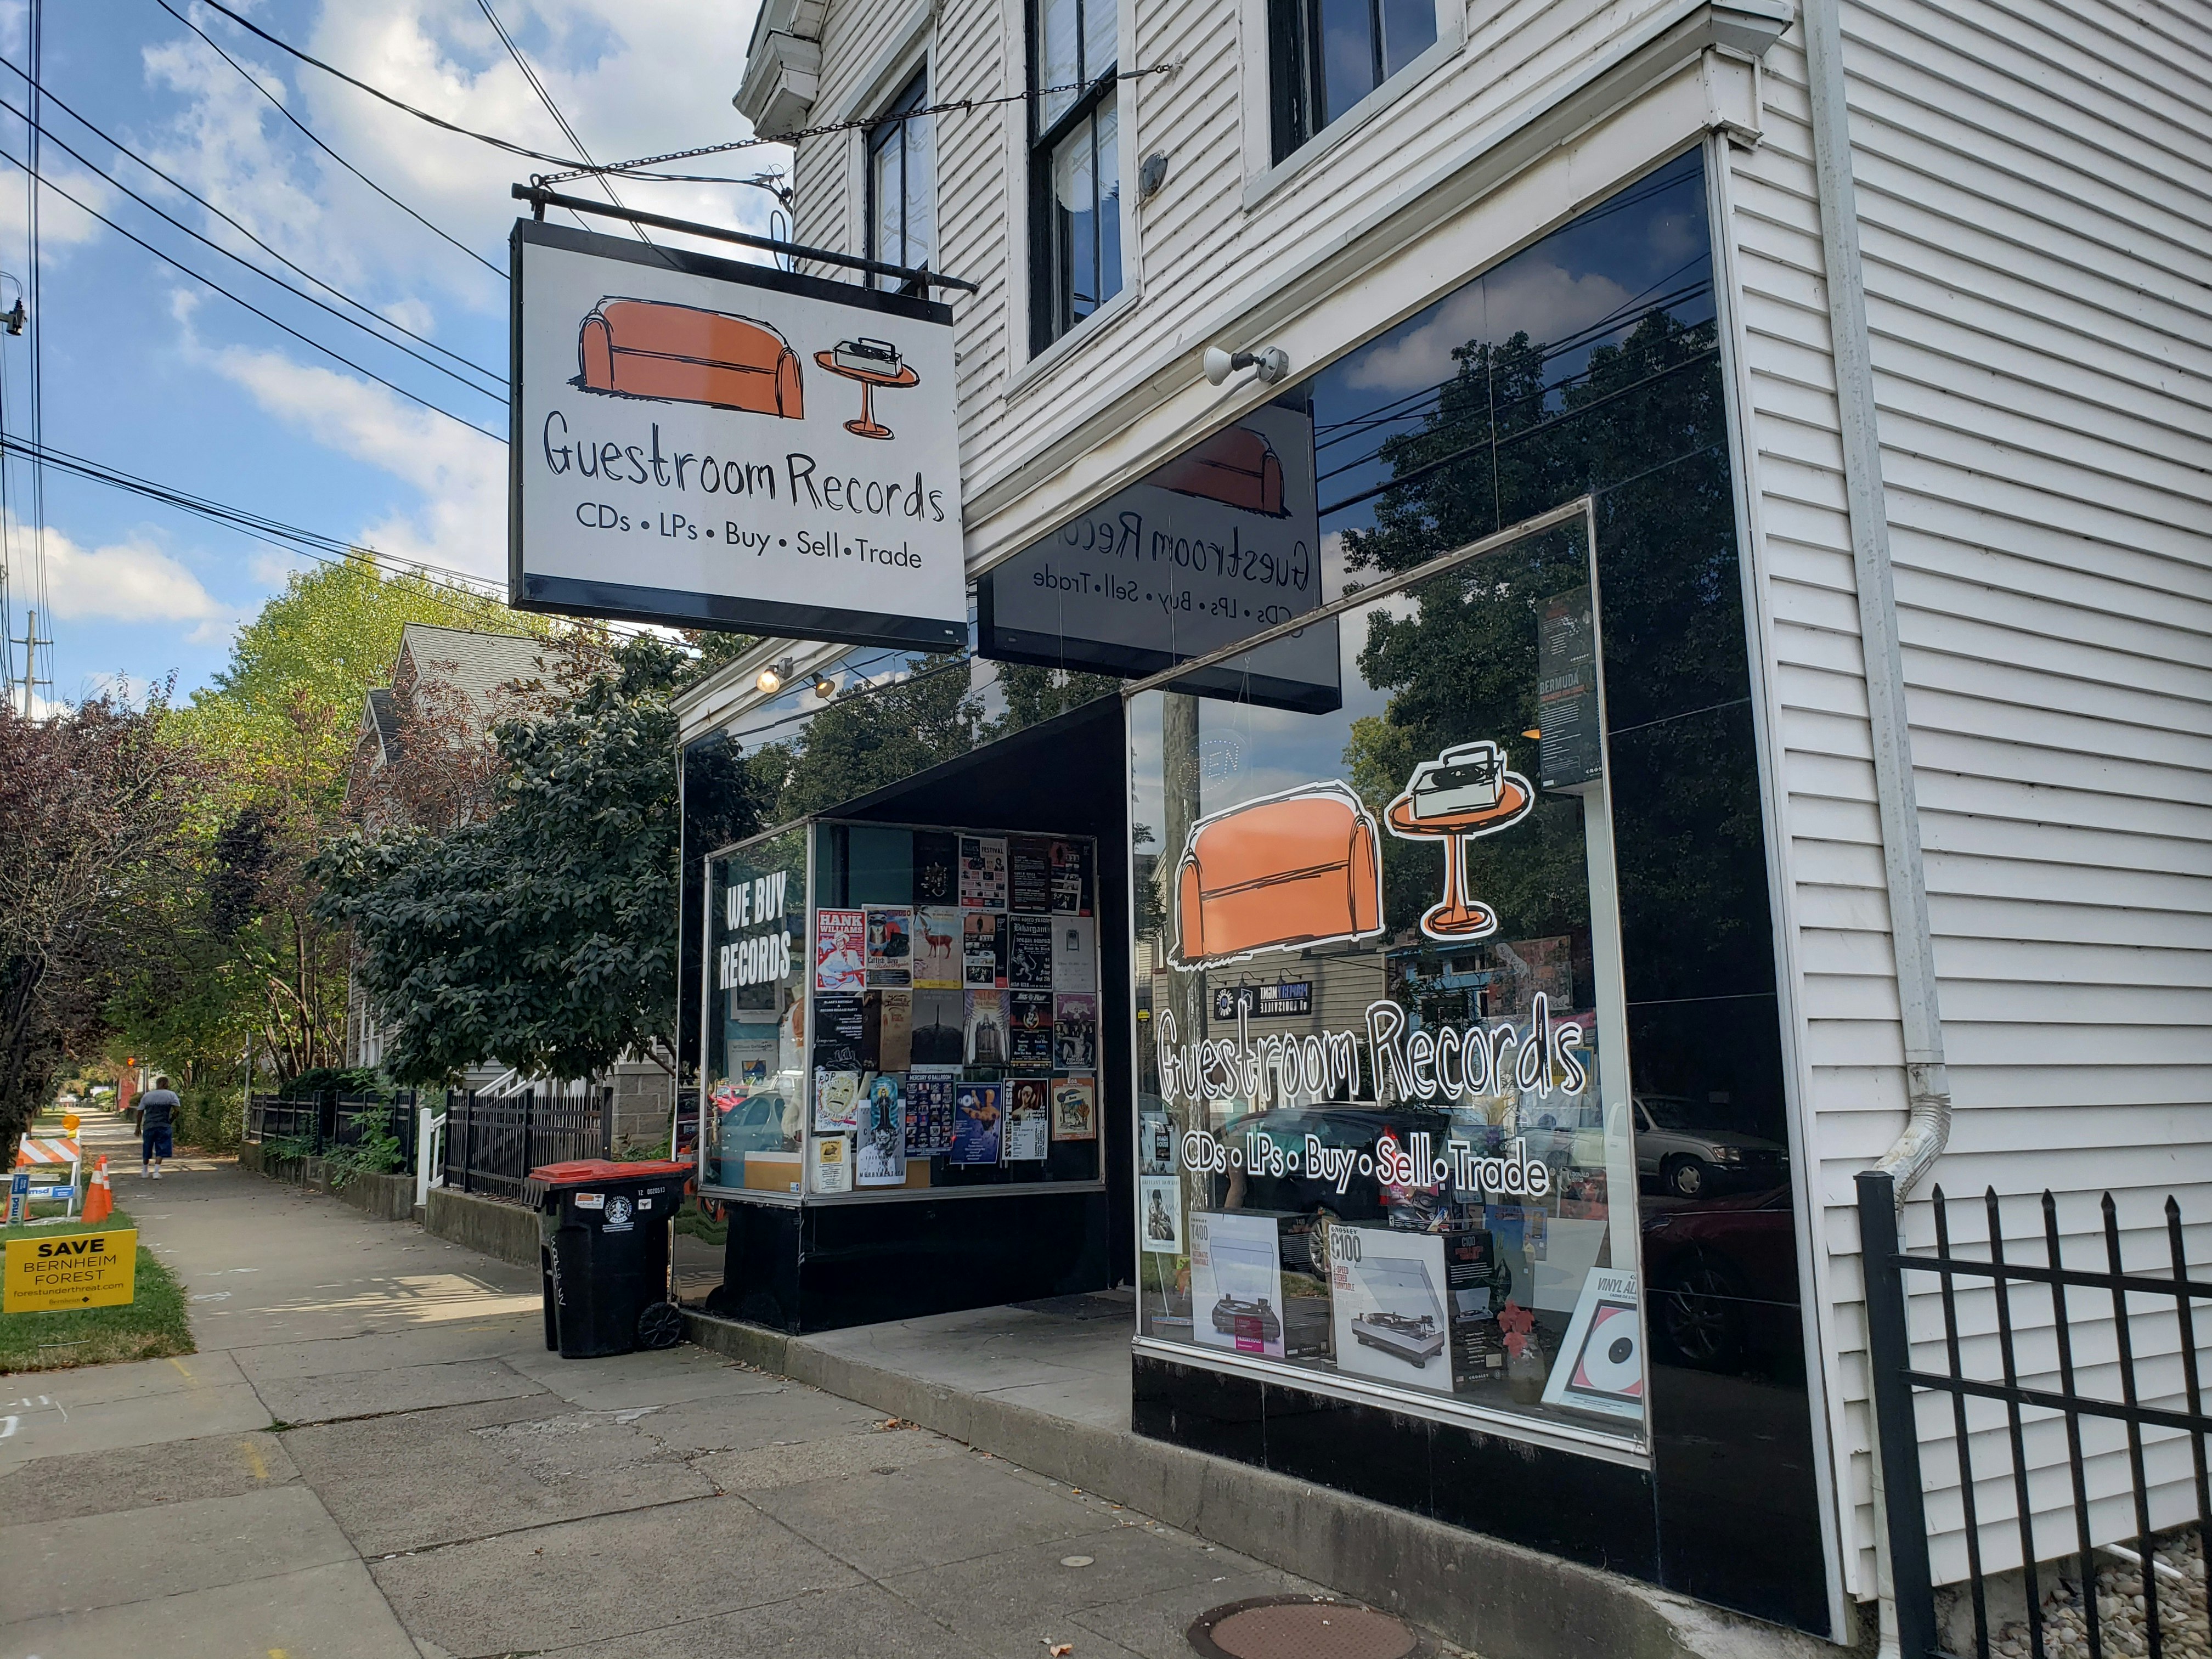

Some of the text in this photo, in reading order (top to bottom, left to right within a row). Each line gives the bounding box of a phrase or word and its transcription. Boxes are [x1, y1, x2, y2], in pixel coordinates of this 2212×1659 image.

[543, 410, 946, 523] Guestroom Records
[576, 502, 922, 569] CDs LPs Buy Sell Trade
[1539, 673, 1579, 695] BERMUDA
[727, 871, 787, 930] WE BUY
[820, 914, 863, 927] HANK
[719, 930, 791, 990] RECORDS
[1156, 991, 1587, 1103] Guestroom Records
[1181, 1130, 1551, 1197] CDs LPs Buy Sell Trade
[12, 1197, 20, 1216] msd
[1190, 1224, 1208, 1241] T400
[1331, 1226, 1358, 1234] CROSLEY
[37, 1238, 105, 1257] SAVE
[1331, 1233, 1362, 1262] C100
[1462, 1235, 1476, 1247] C100
[24, 1254, 116, 1273] BERNHEIM
[1333, 1265, 1349, 1274] 2-SPEED
[35, 1269, 105, 1286] FOREST
[1333, 1273, 1347, 1282] STEREO
[1334, 1281, 1355, 1291] TURNTABLE
[1598, 1277, 1637, 1295] VINYL AL
[14, 1283, 124, 1297] forestunderthreat.com
